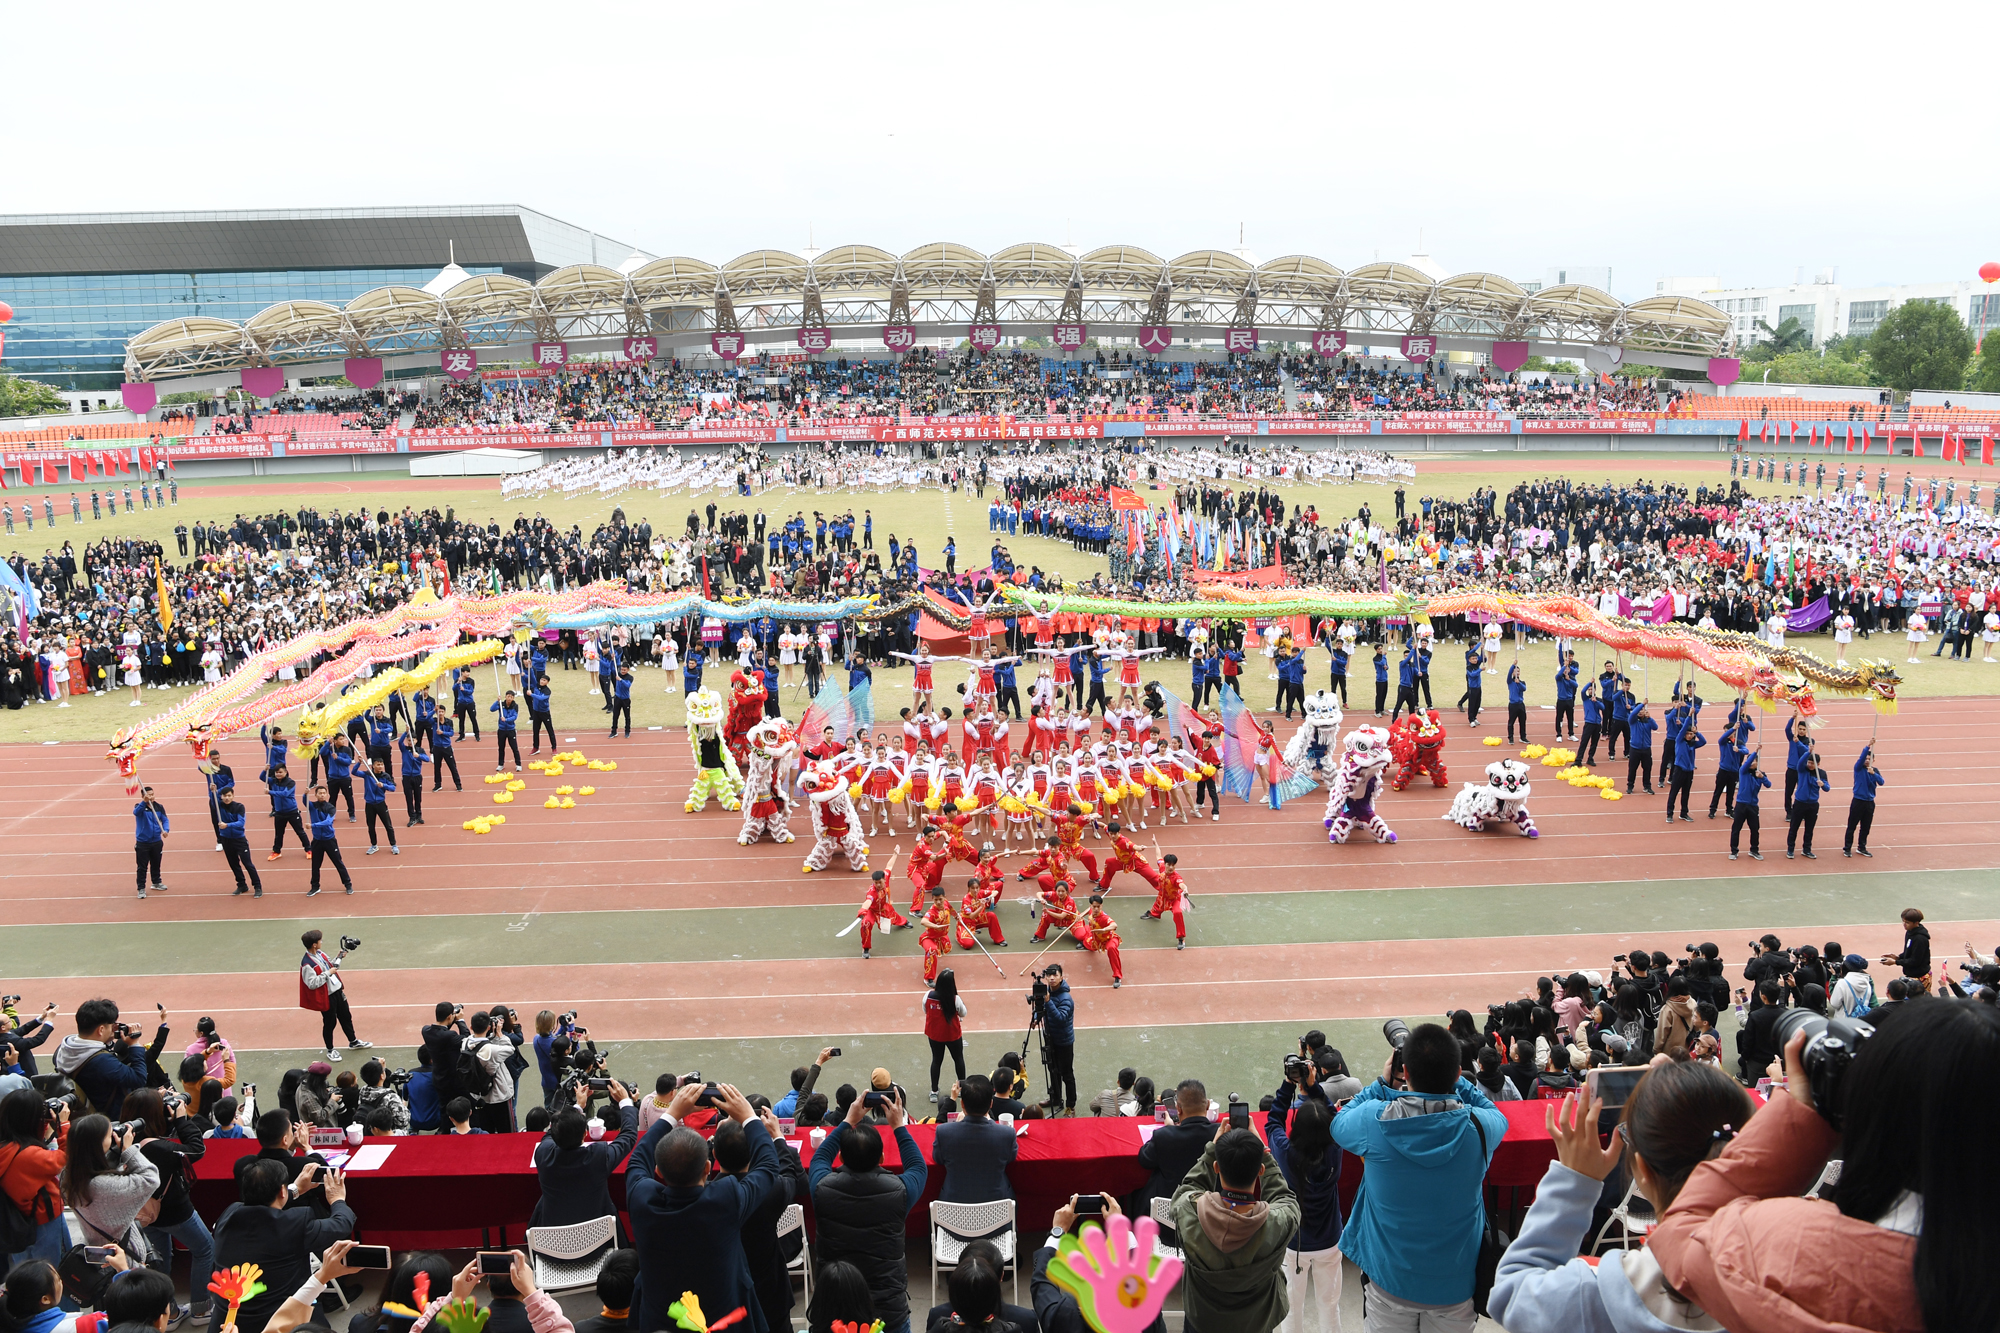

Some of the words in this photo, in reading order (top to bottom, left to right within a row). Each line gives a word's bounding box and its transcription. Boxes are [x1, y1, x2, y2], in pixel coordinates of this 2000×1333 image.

[447, 352, 473, 372] 发
[538, 345, 565, 365] 展
[628, 340, 653, 359] 体
[715, 336, 741, 353] 育
[801, 332, 827, 349] 运
[887, 330, 913, 347] 动
[973, 329, 998, 346] 增
[1057, 328, 1082, 345] 强
[1143, 330, 1168, 347] 人
[1229, 332, 1255, 350] 民
[1316, 334, 1342, 353] 体
[1405, 338, 1432, 358] 质
[1227, 1191, 1248, 1200] Canon
